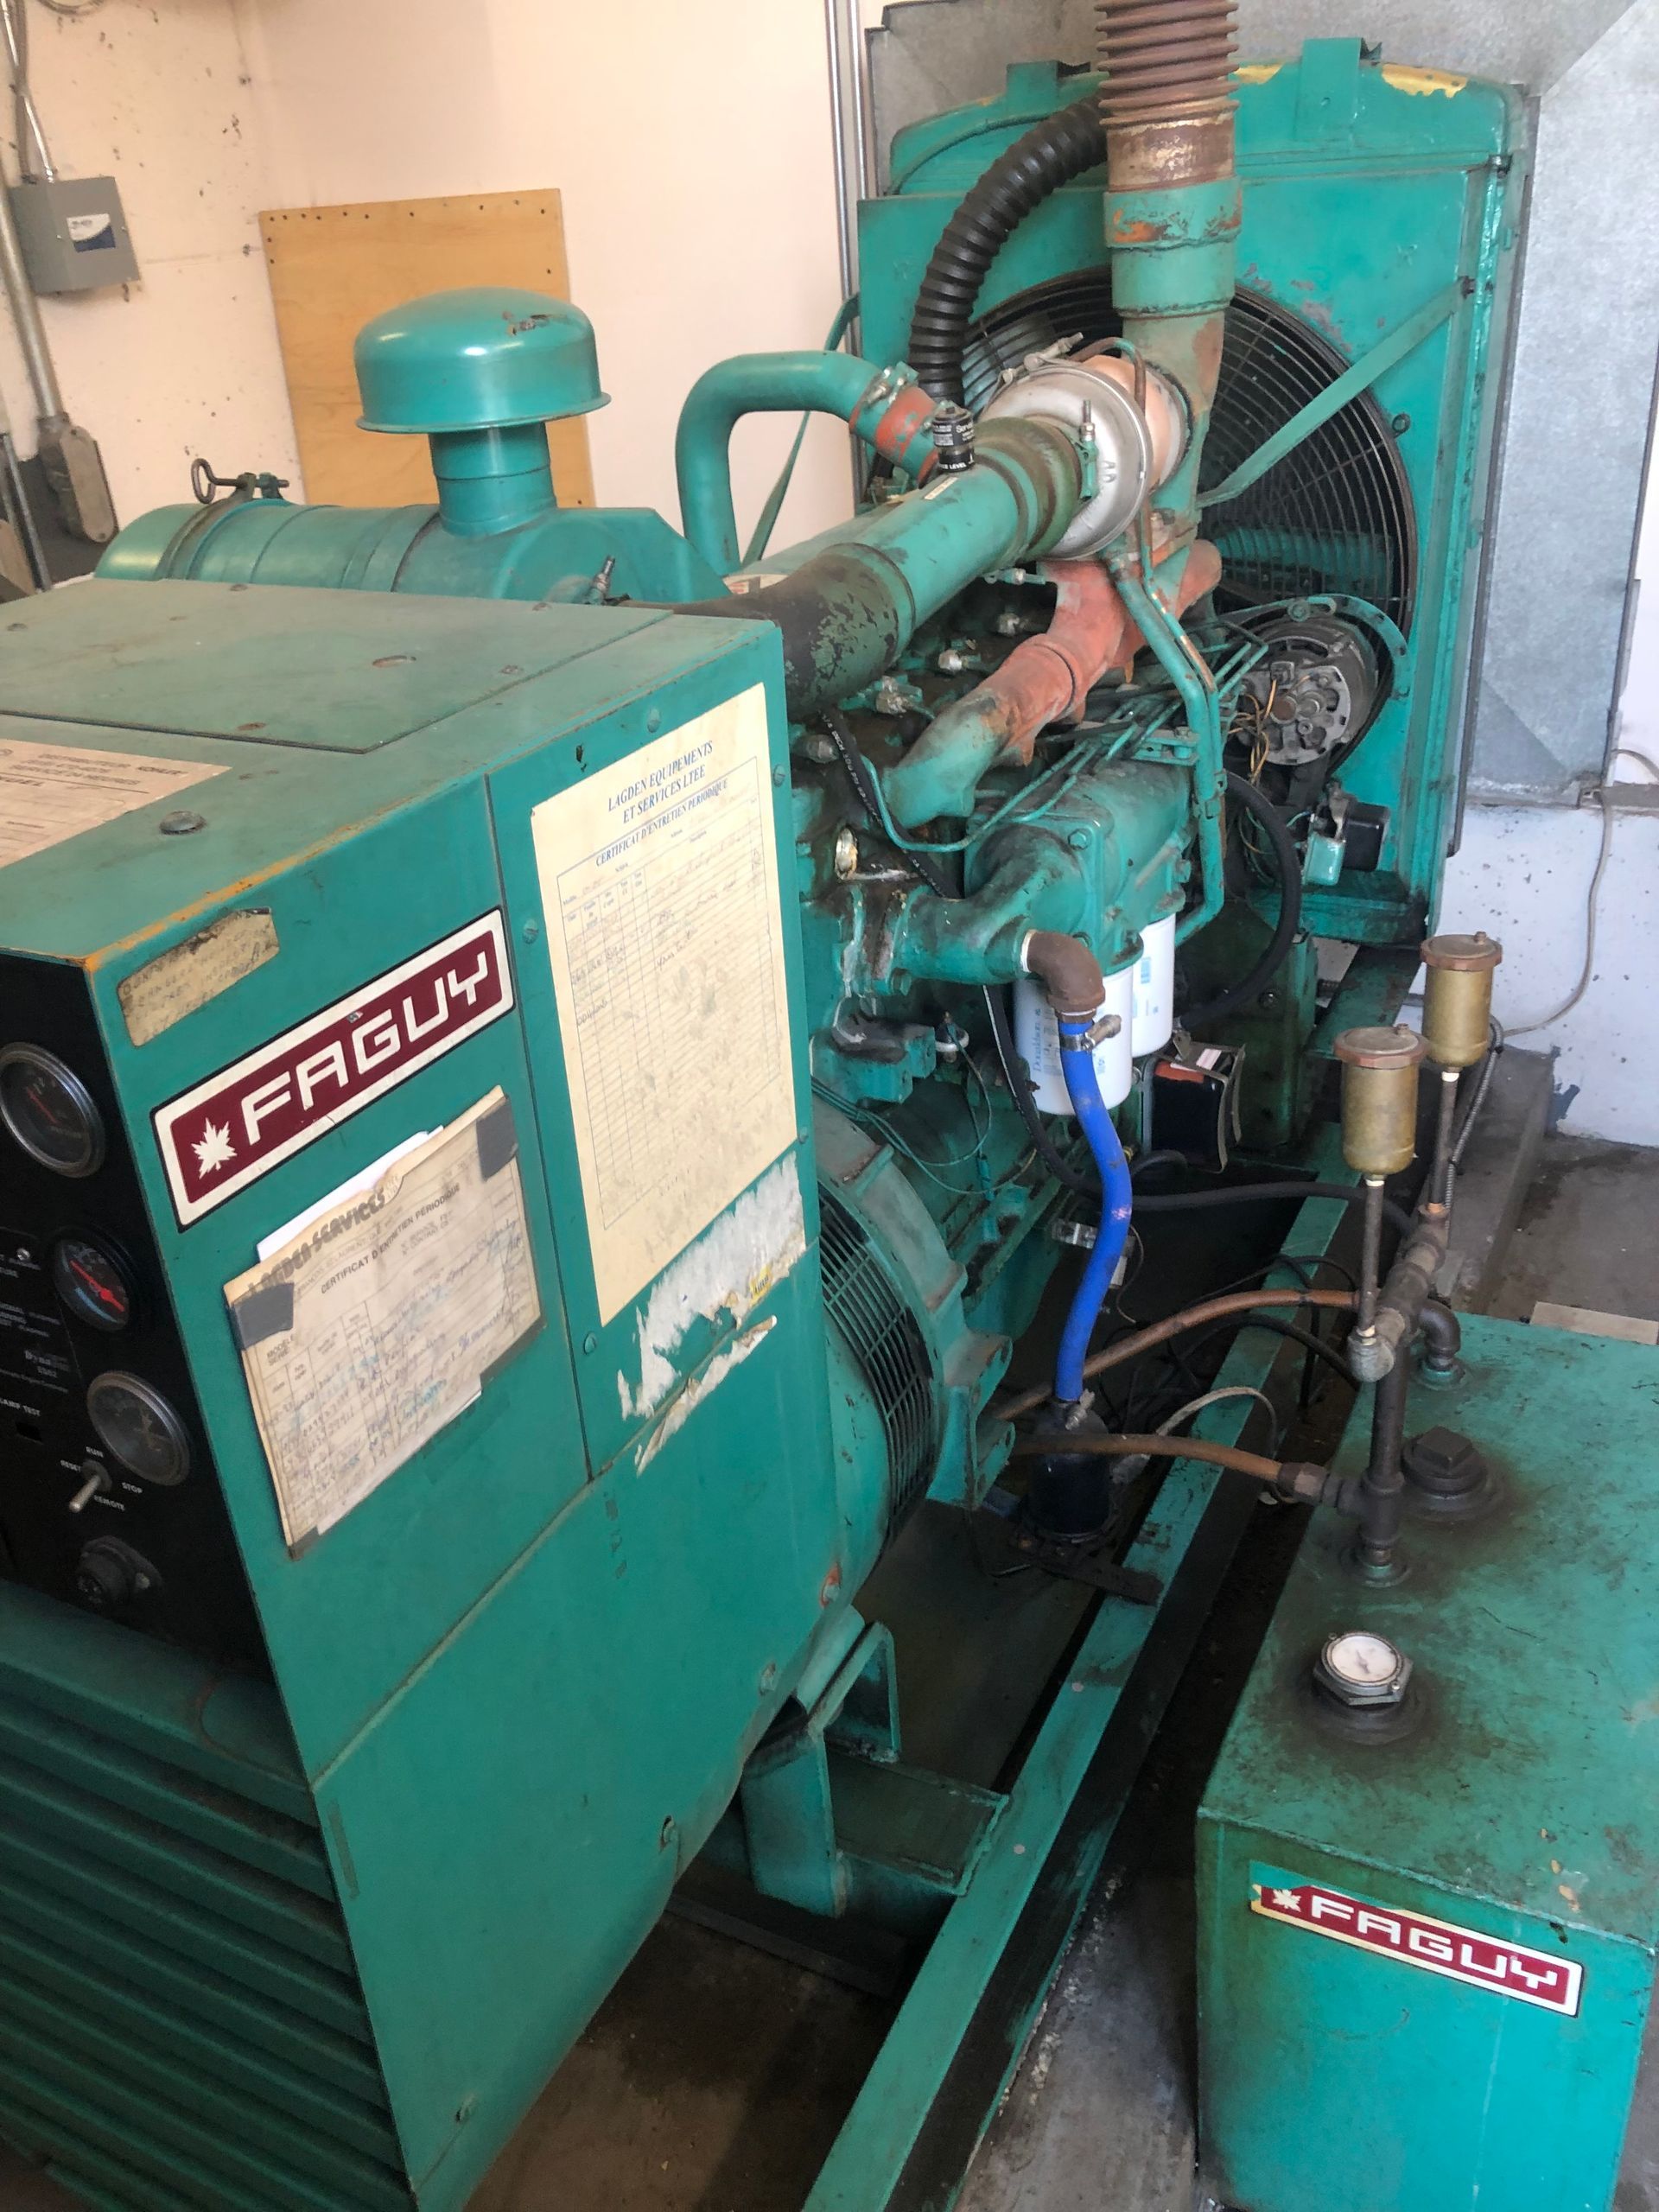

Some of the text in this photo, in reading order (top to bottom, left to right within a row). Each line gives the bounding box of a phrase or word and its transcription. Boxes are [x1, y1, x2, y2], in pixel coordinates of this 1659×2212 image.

[607, 740, 713, 812] LAGDEN EQUIPEMENTS
[623, 804, 636, 824] ET
[637, 778, 682, 817] SERVICES
[595, 830, 641, 867] CERTIFICAT
[240, 950, 488, 1146] FAGUY
[321, 1256, 370, 1294] CERTIFICAT
[86, 1446, 104, 1459] RUN
[121, 1481, 143, 1494] STOP
[1311, 1894, 1558, 1989] FAGUY
